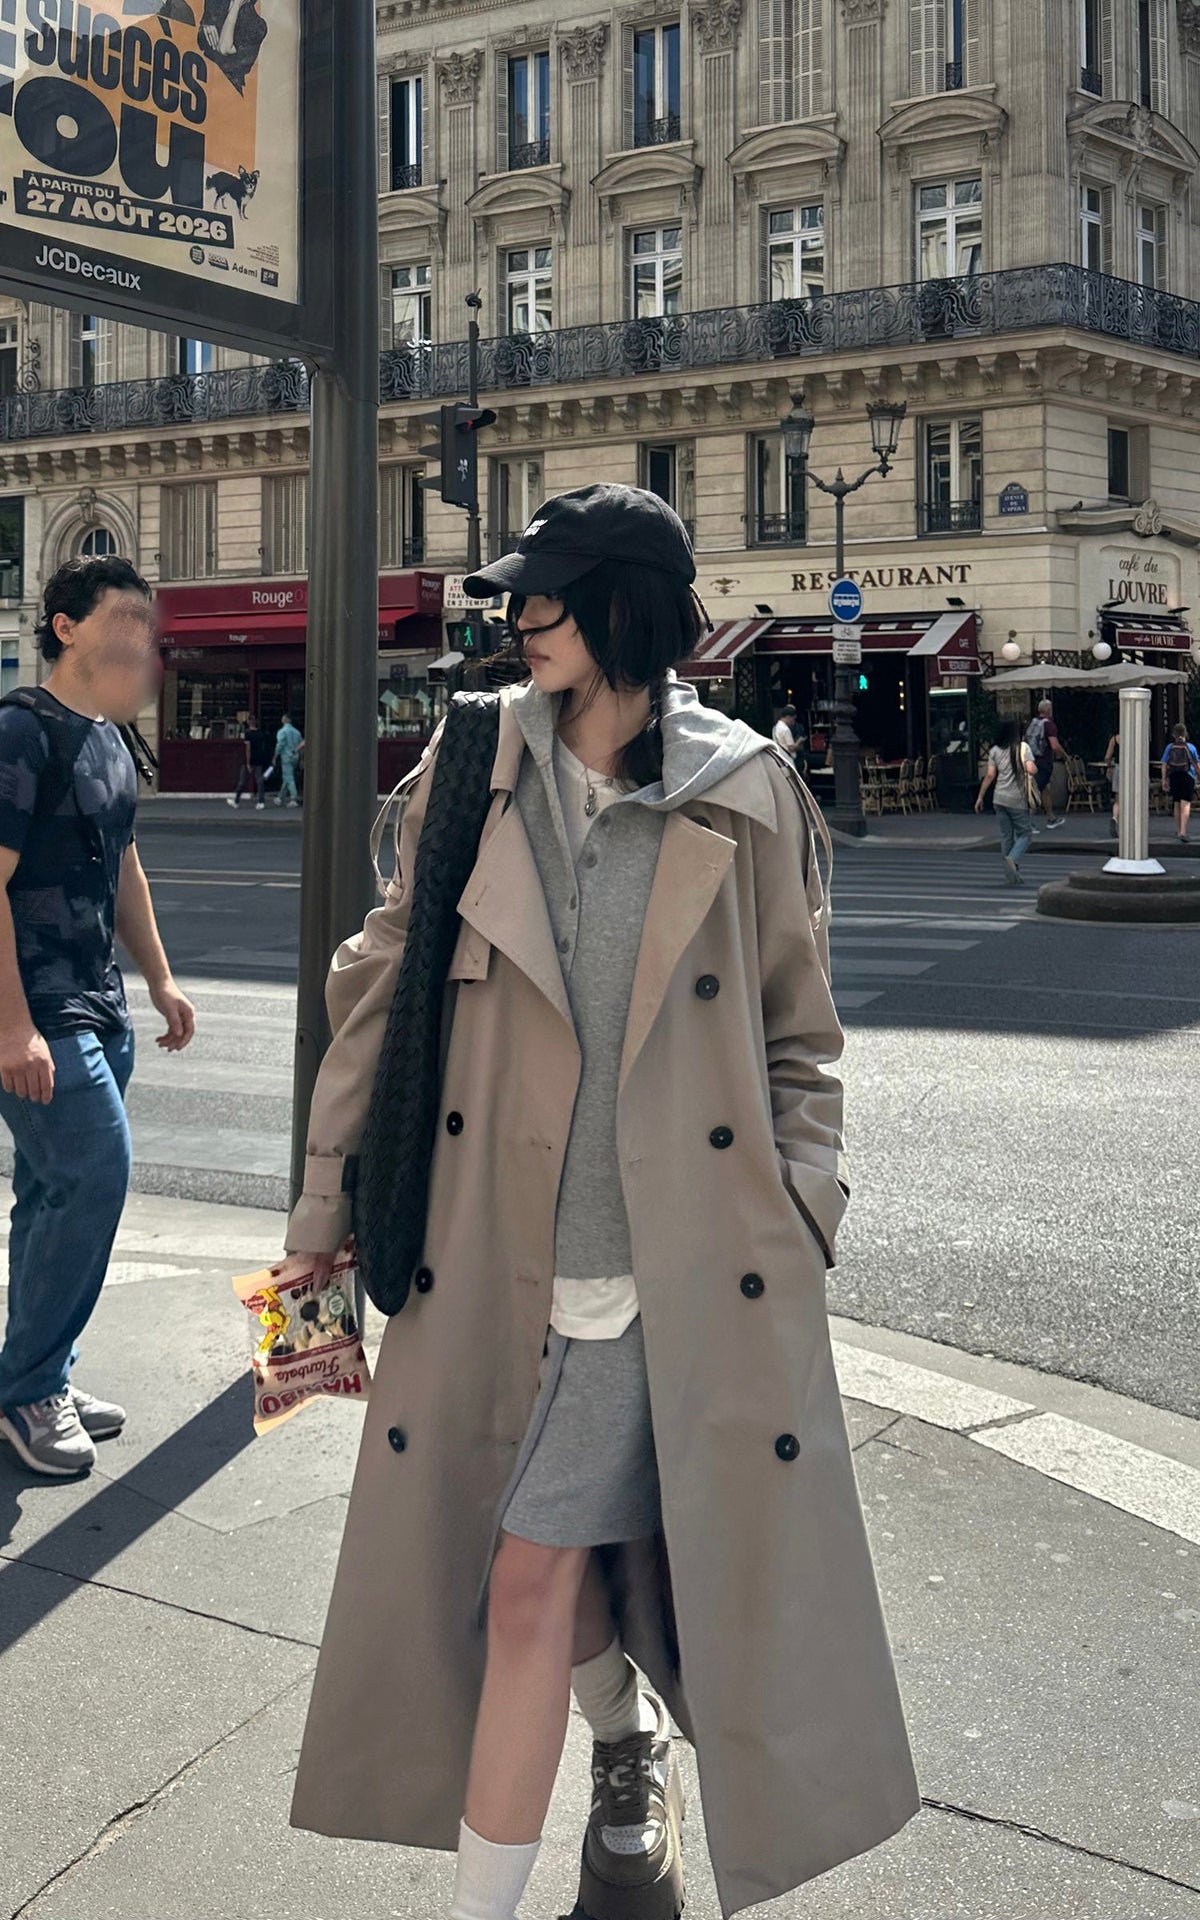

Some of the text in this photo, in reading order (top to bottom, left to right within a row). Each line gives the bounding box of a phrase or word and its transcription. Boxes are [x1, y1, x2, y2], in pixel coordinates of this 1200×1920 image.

[24, 0, 208, 125] succès
[28, 173, 115, 199] À PARTIR DU
[26, 189, 65, 214] 27
[70, 196, 154, 230] AOÛT
[158, 211, 228, 242] 2026
[35, 245, 142, 291] JCDecaux
[231, 262, 258, 278] Adami
[1119, 553, 1159, 577] café du
[251, 590, 294, 608] Rouge
[1108, 578, 1168, 605] LOUVRE
